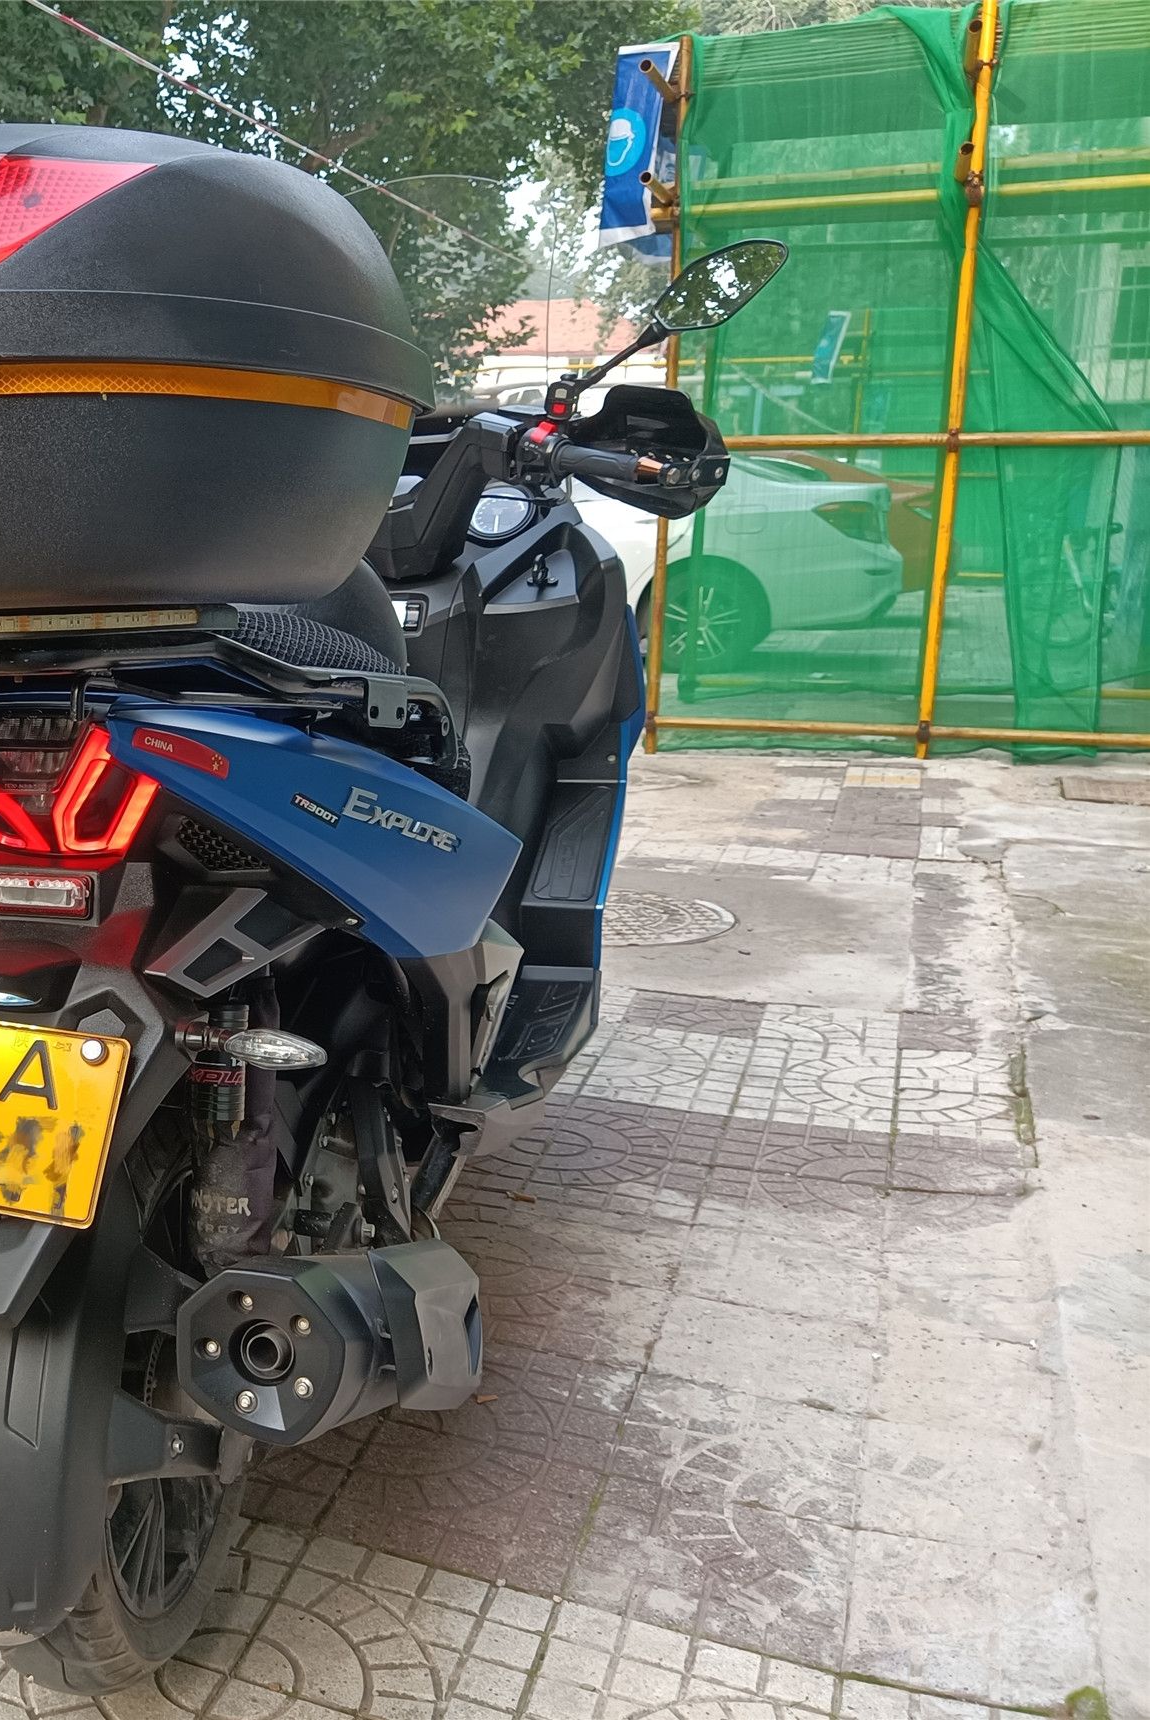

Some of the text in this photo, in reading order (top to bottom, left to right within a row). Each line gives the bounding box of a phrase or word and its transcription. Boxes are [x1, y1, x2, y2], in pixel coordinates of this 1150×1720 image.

[144, 736, 174, 753] CHINA
[294, 794, 339, 824] TR300T
[342, 786, 458, 852] EXPLORE
